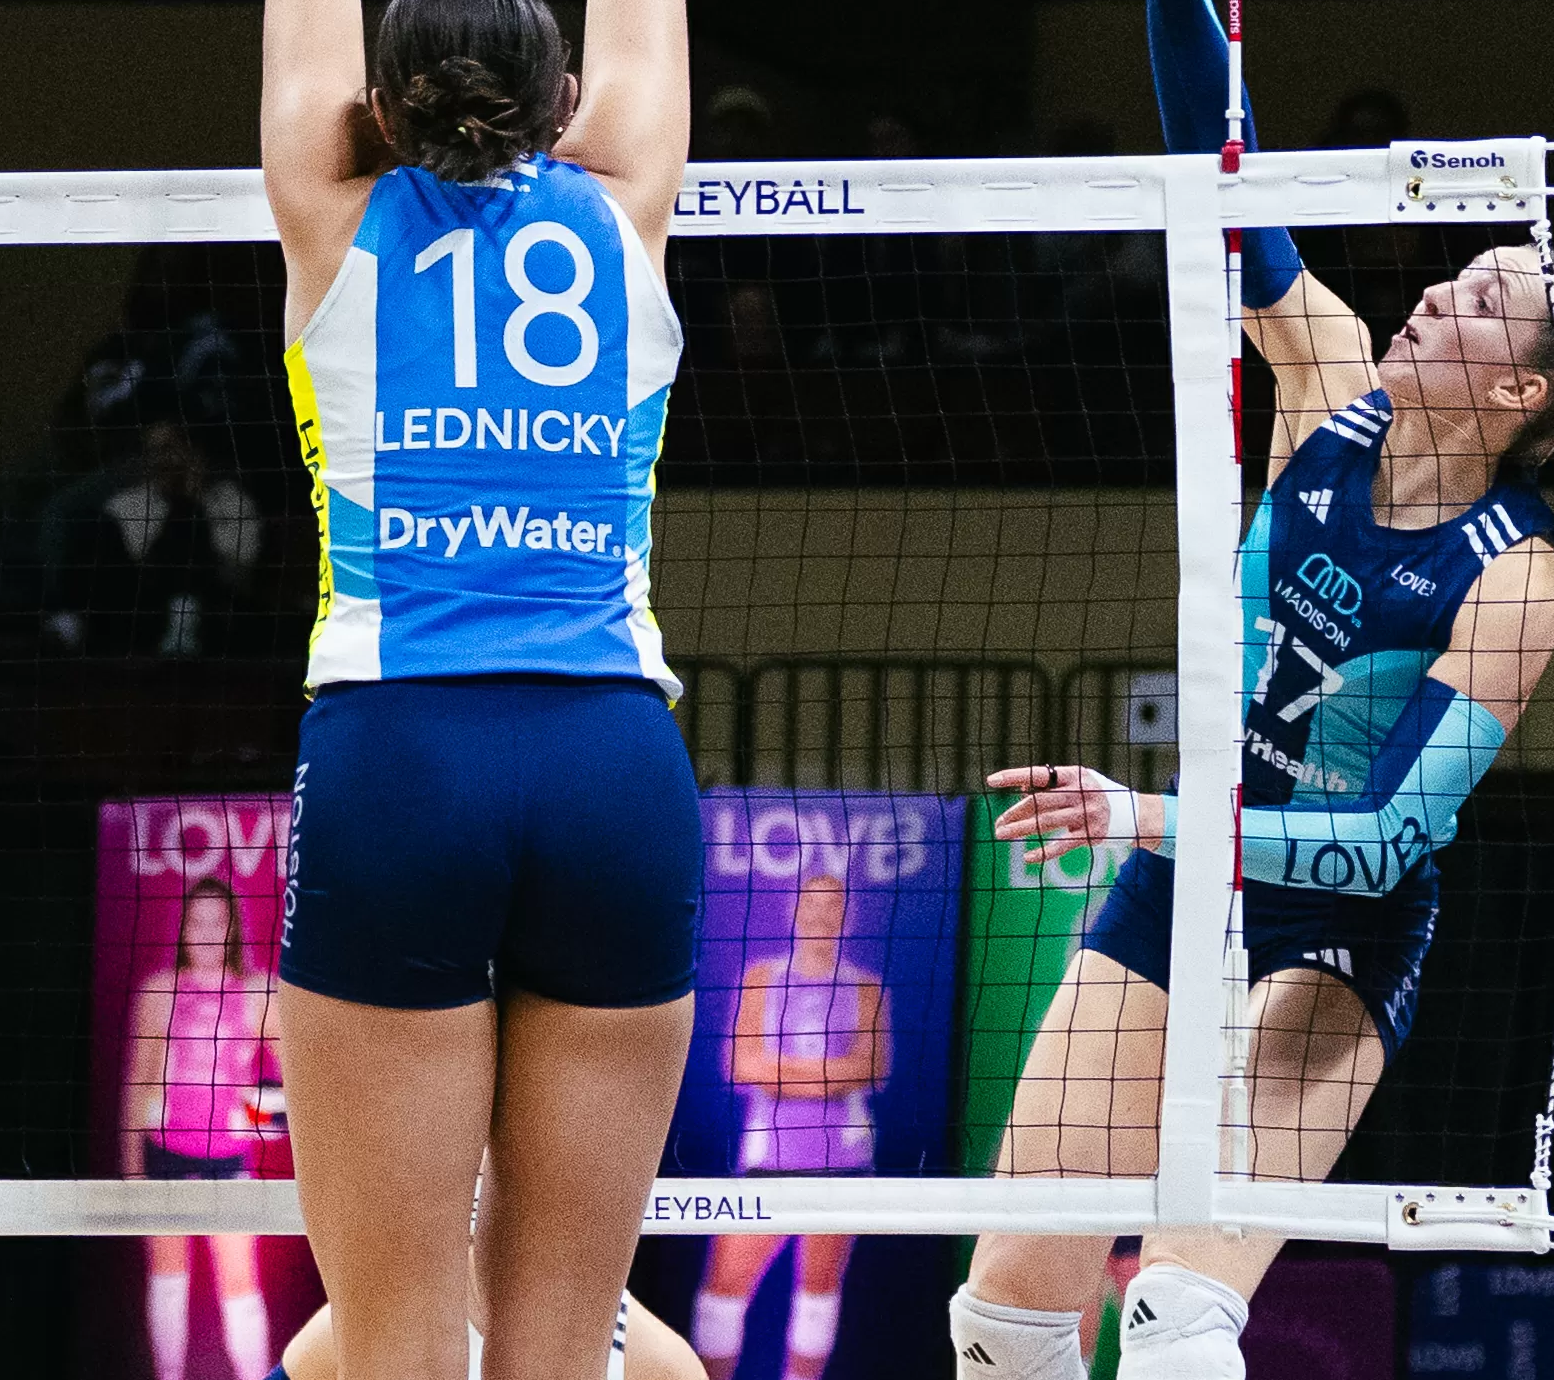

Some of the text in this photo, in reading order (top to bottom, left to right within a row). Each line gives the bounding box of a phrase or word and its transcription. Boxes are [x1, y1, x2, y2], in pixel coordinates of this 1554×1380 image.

[1431, 152, 1505, 169] Senoh
[674, 179, 865, 217] LEYBALL
[414, 220, 600, 388] 18
[375, 407, 627, 458] LEDNICKY
[379, 505, 622, 559] DryWater.
[1275, 579, 1351, 653] MADISON
[1253, 616, 1345, 723] 17
[128, 805, 288, 879] LOV
[714, 806, 928, 881] LOVB
[1282, 816, 1430, 894] LOVB
[644, 1196, 772, 1220] EYBALL
